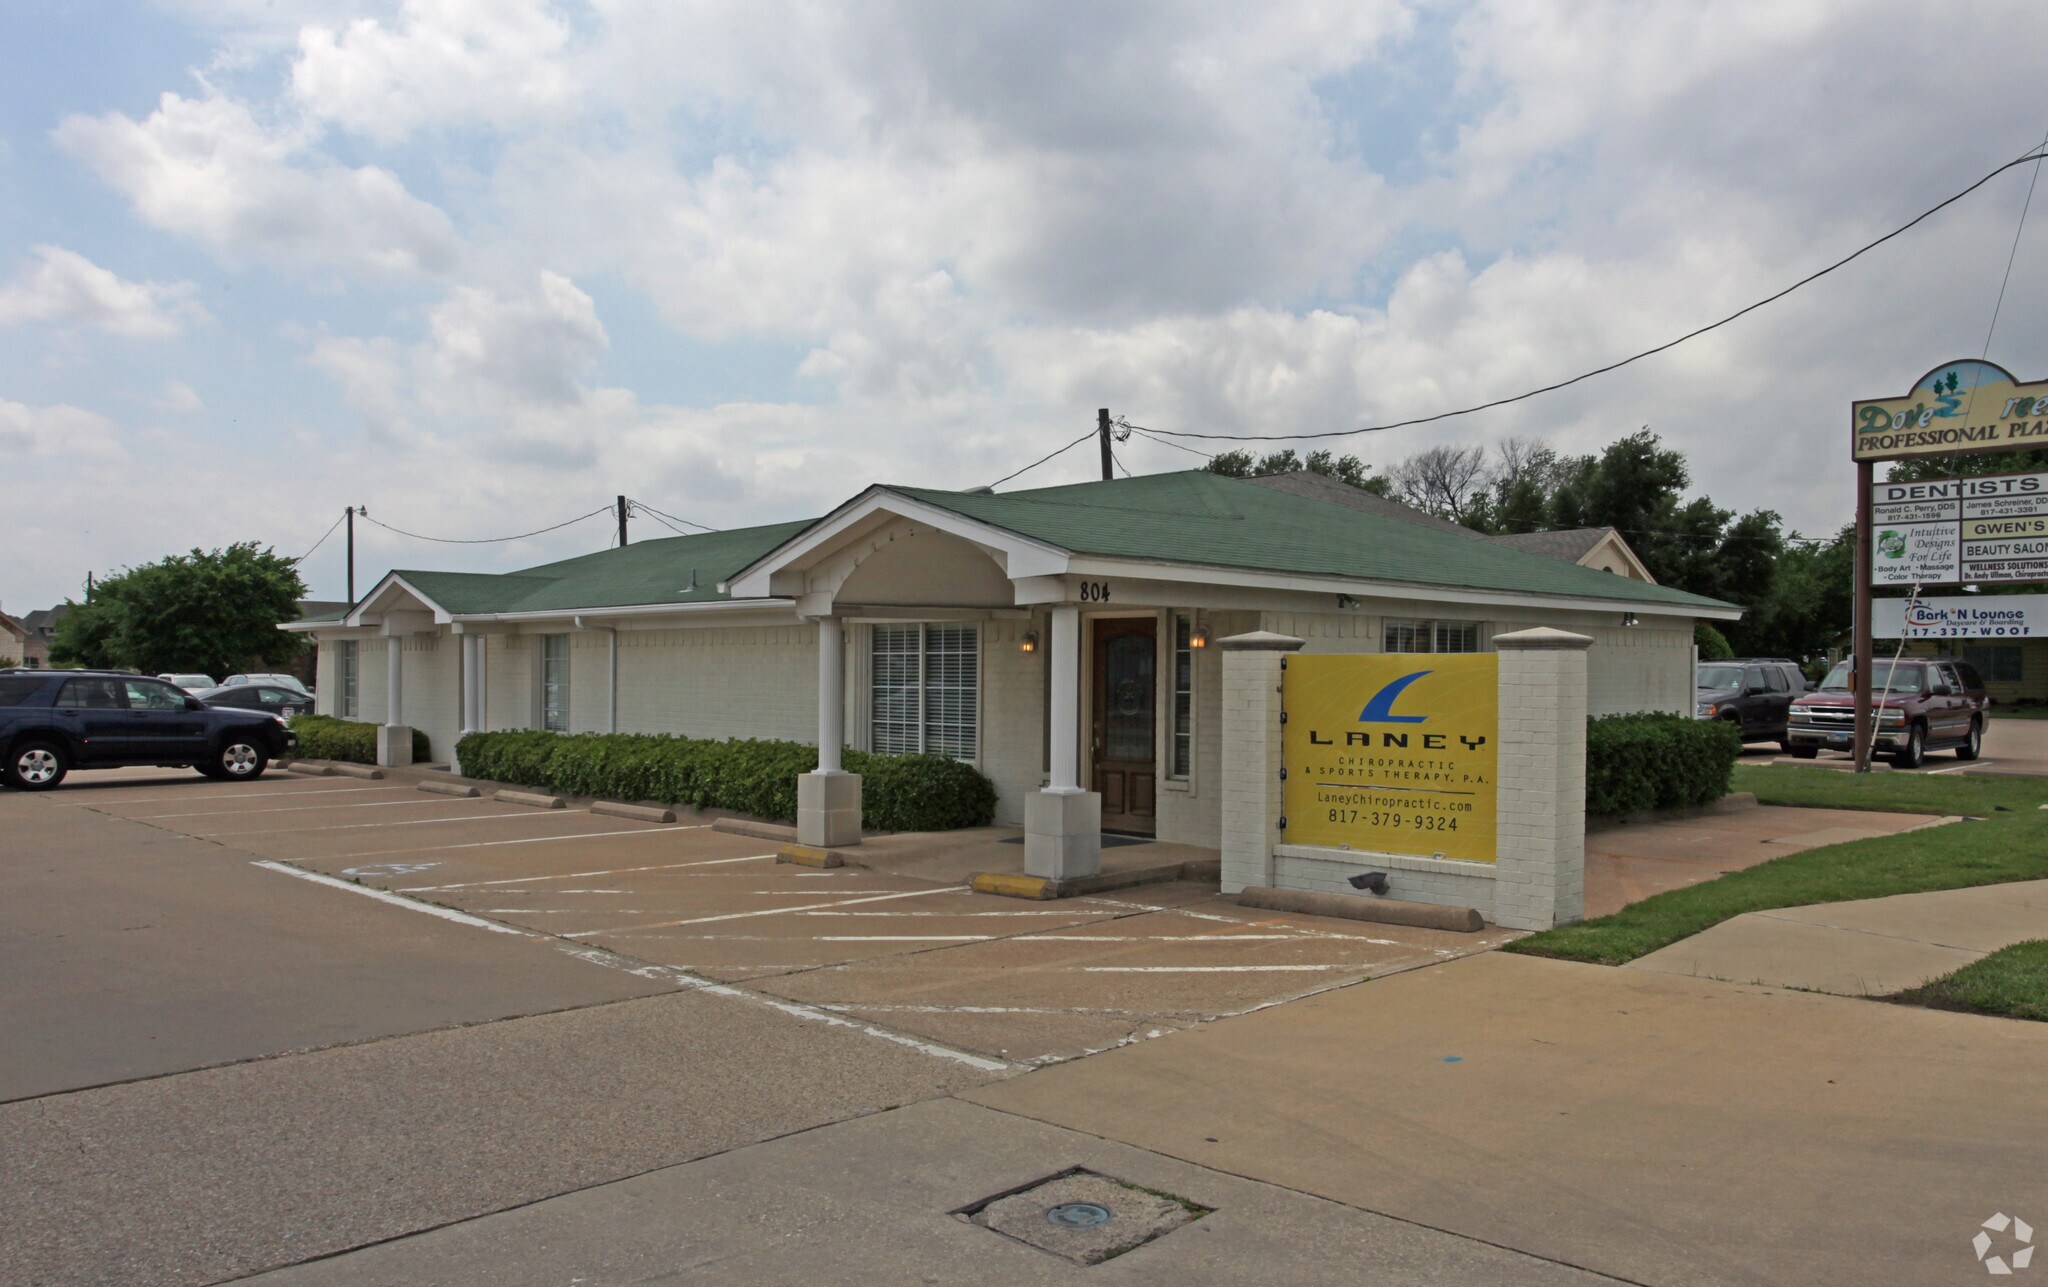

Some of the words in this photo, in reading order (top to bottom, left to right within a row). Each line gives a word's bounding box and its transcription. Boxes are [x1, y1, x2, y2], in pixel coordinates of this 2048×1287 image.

[1858, 402, 1935, 435] Dove
[1857, 425, 1999, 451] PROFESSIONAL
[1888, 477, 2040, 500] DENTISTS
[1875, 507, 1901, 515] Ronald
[1938, 503, 1955, 511] DDS
[1980, 506, 2038, 516] 817-431-3391
[1888, 512, 1941, 521] 817-431-1596
[1910, 526, 1956, 537] Intuitive
[1974, 520, 2045, 535] GWEN'S
[1914, 538, 1955, 550] Designs
[1967, 544, 2011, 556] BEAUTY
[1909, 552, 1928, 562] For
[1931, 550, 1952, 563] Life
[1969, 562, 2005, 571] WELLNESS
[1080, 581, 1111, 602] 804
[1917, 609, 1948, 620] Bark
[1972, 609, 2024, 620] Lounge
[1946, 619, 1977, 627] Daycare
[1309, 731, 1486, 751] LANEY
[1338, 757, 1455, 770] CHIROPRACTIC
[1305, 766, 1311, 774] &
[1319, 767, 1374, 777] SPORTS
[1463, 775, 1490, 784] P.A.
[1317, 791, 1472, 812] LaneyChiropractic.com
[1328, 808, 1458, 832] 817-379-9324
